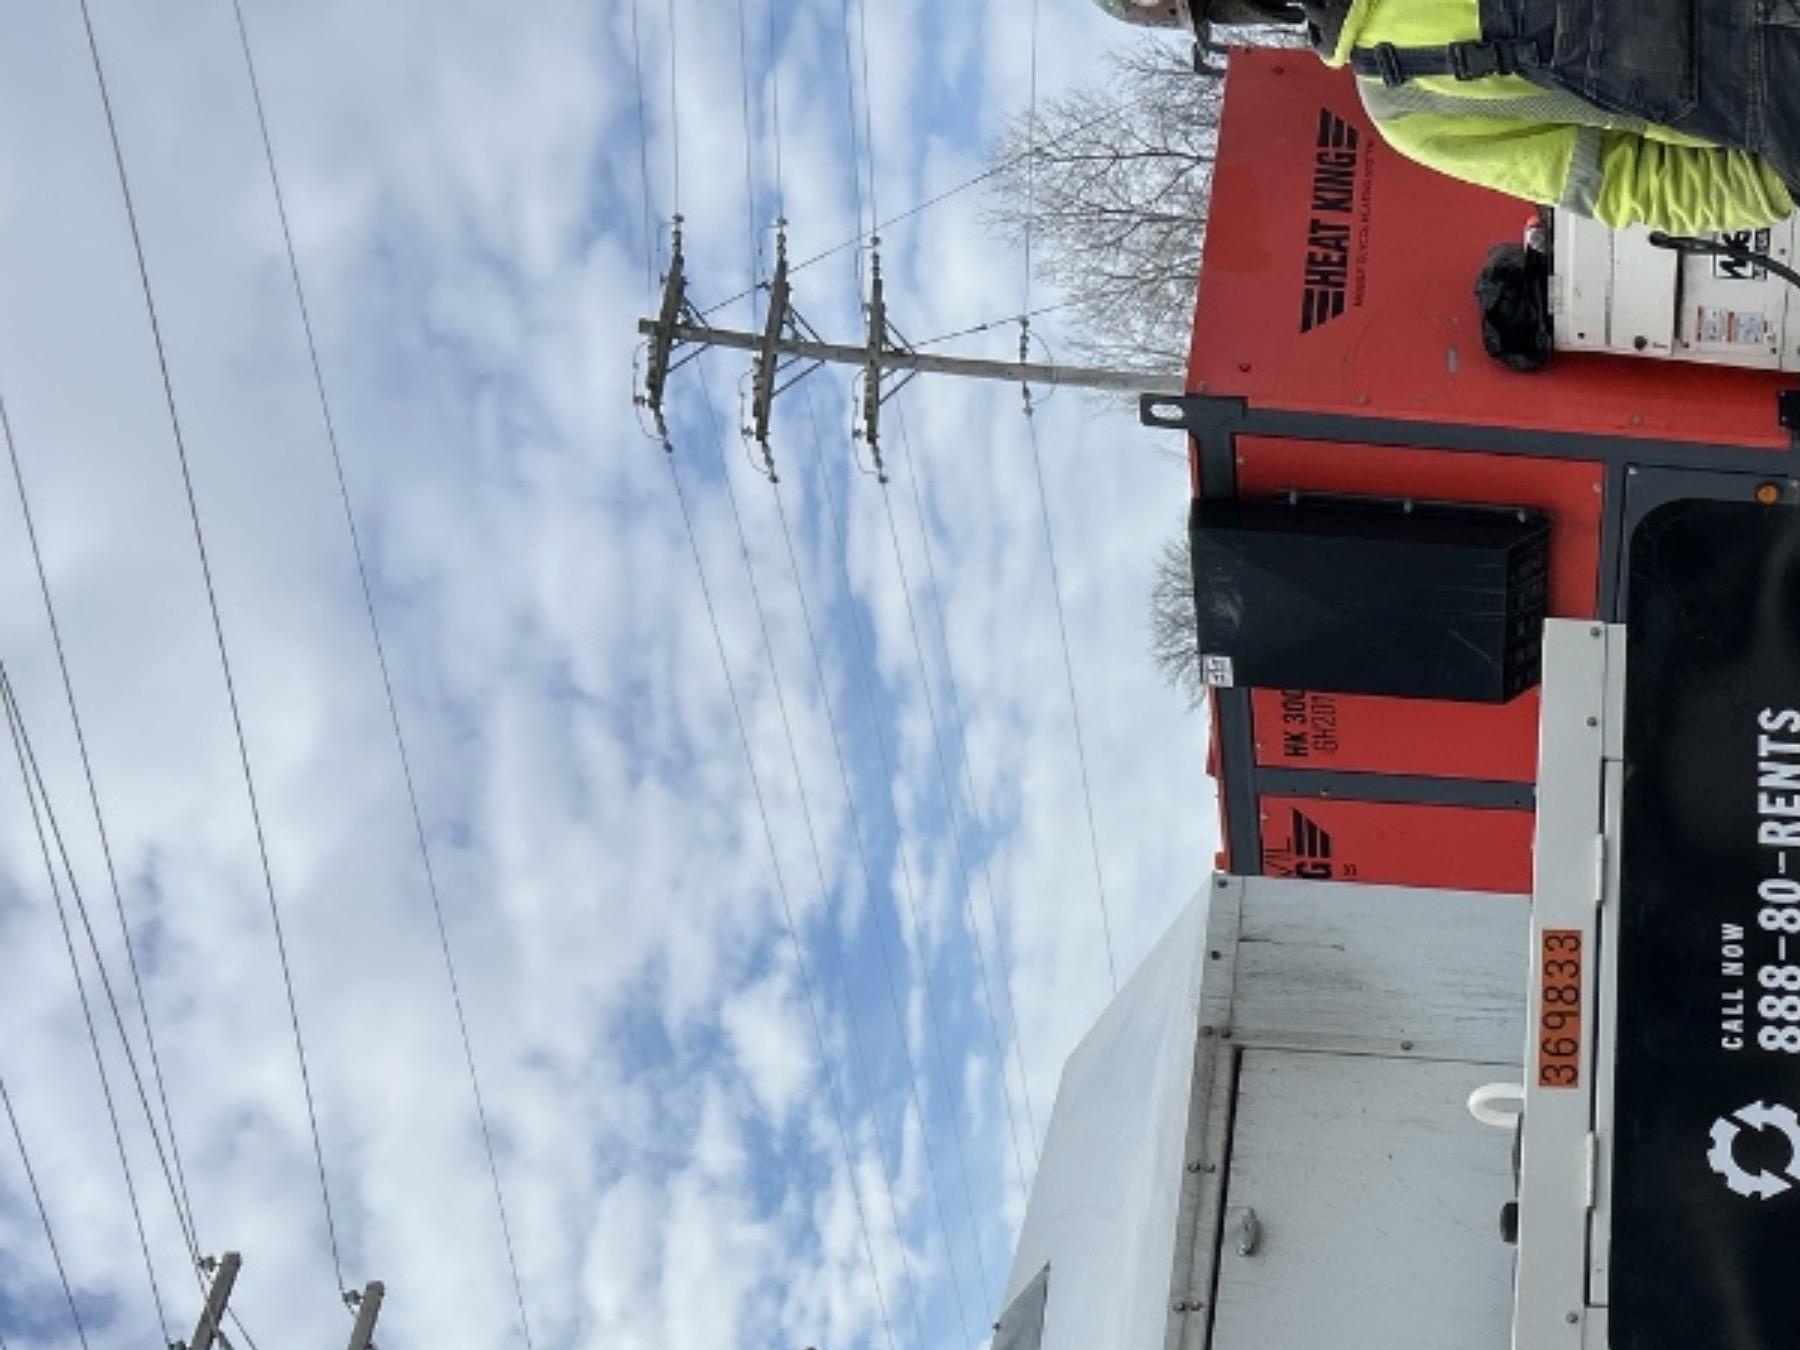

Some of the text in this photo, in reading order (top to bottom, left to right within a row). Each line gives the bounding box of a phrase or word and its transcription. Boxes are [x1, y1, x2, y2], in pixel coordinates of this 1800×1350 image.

[1304, 151, 1357, 289] HEAT KING
[1541, 934, 1580, 1085] 369833
[1720, 922, 1745, 1051] CALL NOW
